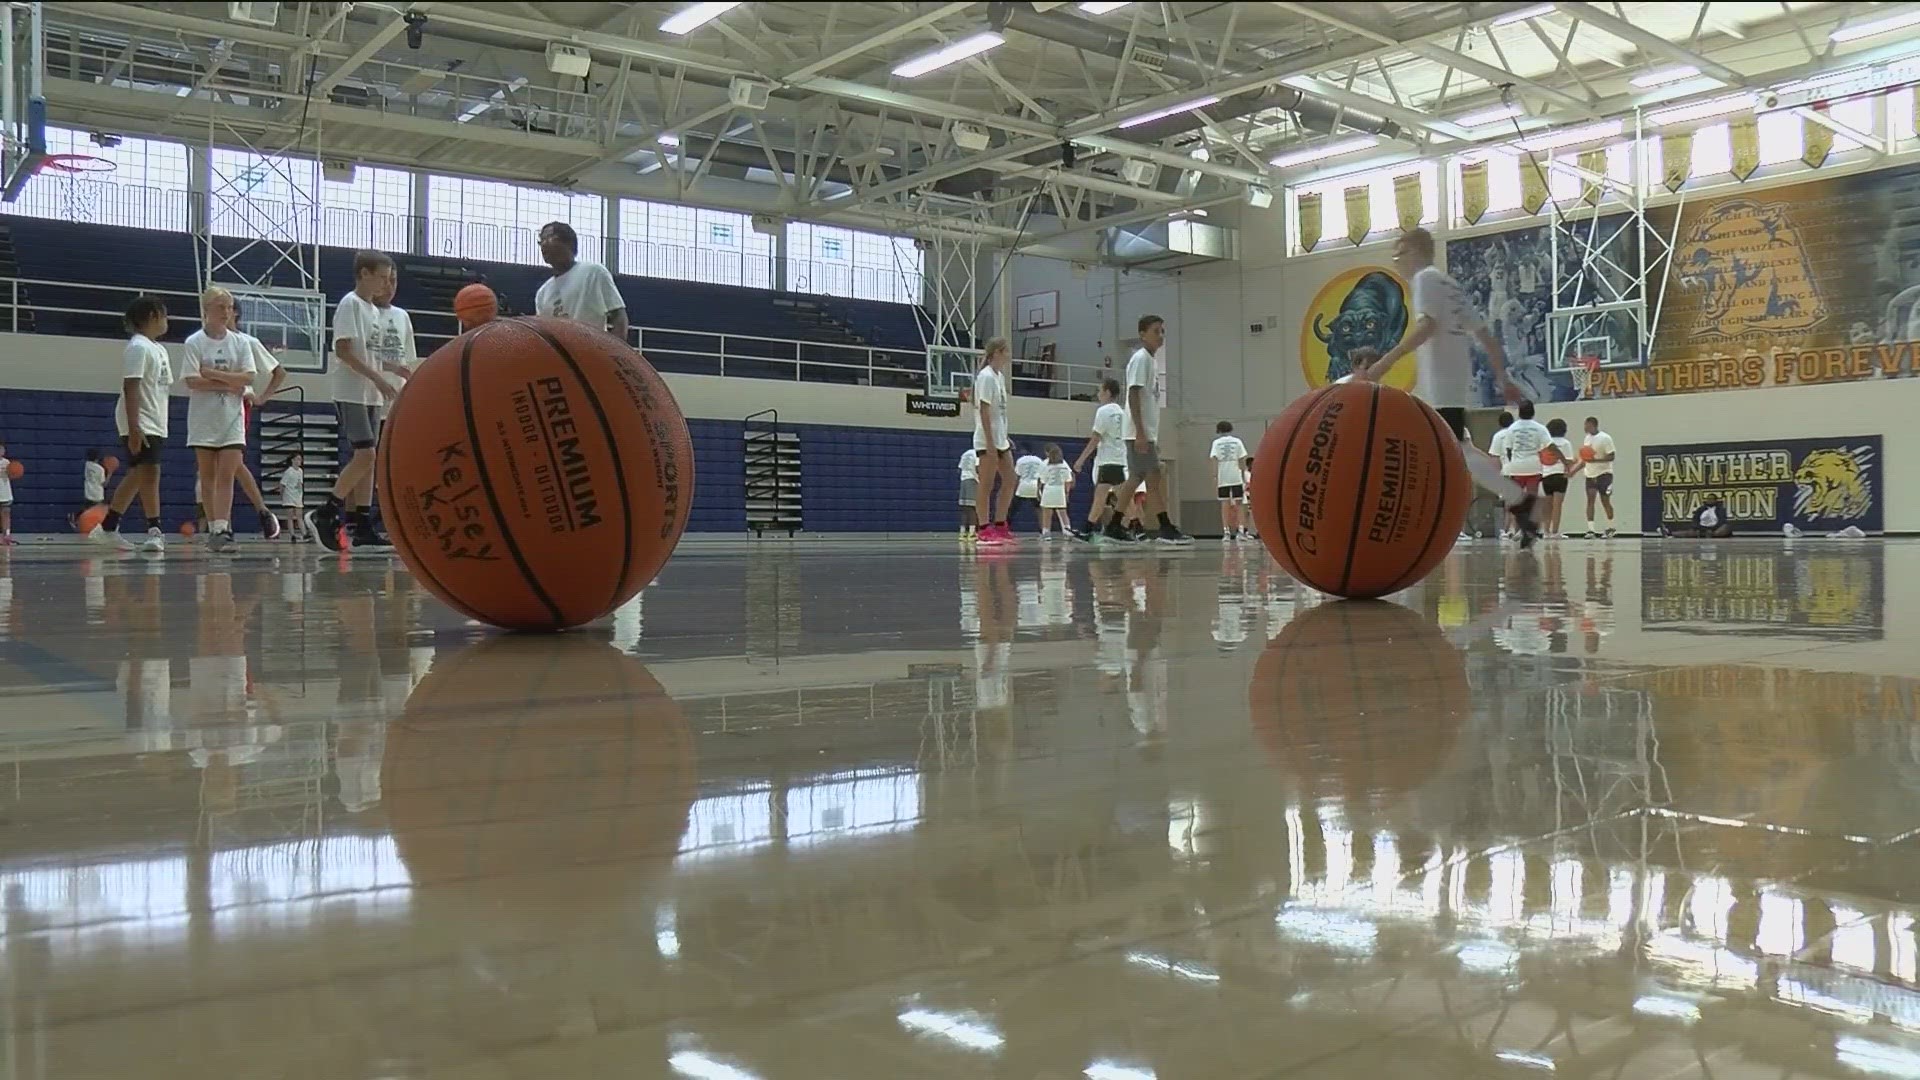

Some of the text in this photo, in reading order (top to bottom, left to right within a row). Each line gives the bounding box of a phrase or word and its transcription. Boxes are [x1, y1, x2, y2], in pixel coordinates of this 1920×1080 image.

[1741, 298, 1766, 306] OUR
[911, 400, 957, 411] WHITMER
[1584, 354, 1765, 396] PANTHERS
[436, 440, 501, 561] Kelsey
[512, 390, 538, 444] INDOOR
[534, 464, 566, 534] OUTDOOR
[538, 376, 602, 529] PREMIUM
[1300, 401, 1344, 530] EPIC SPORTS
[1368, 437, 1401, 543] PREMIUM
[1646, 450, 1793, 487] PANTHER
